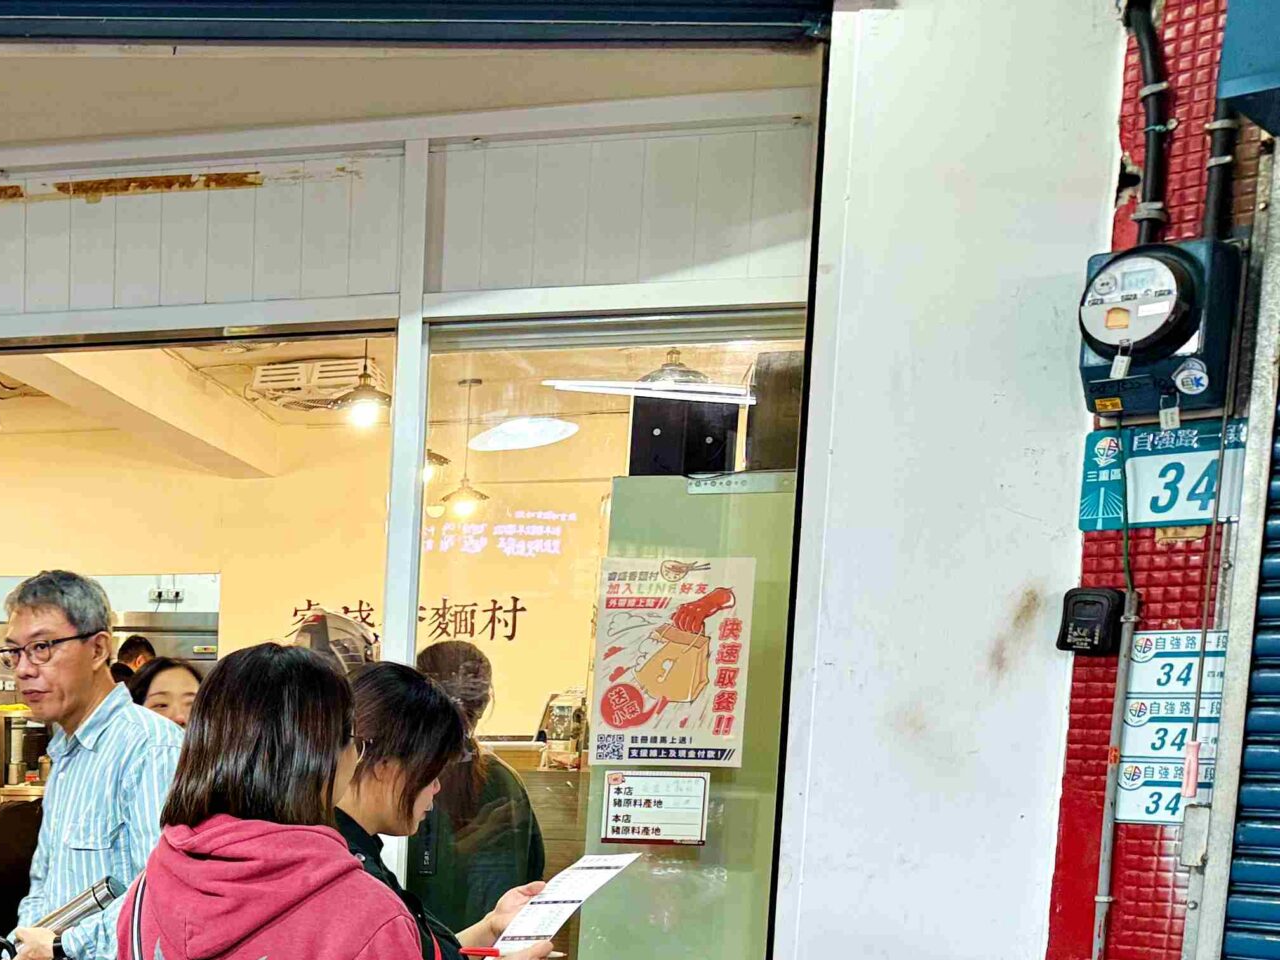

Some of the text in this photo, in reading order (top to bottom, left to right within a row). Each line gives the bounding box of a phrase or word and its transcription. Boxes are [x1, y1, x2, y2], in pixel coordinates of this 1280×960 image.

[1150, 458, 1219, 514] 34
[1156, 662, 1194, 687] 34
[1150, 727, 1188, 752] 34
[614, 786, 633, 796] 本店
[1145, 791, 1182, 816] 34
[612, 814, 632, 824] 本店
